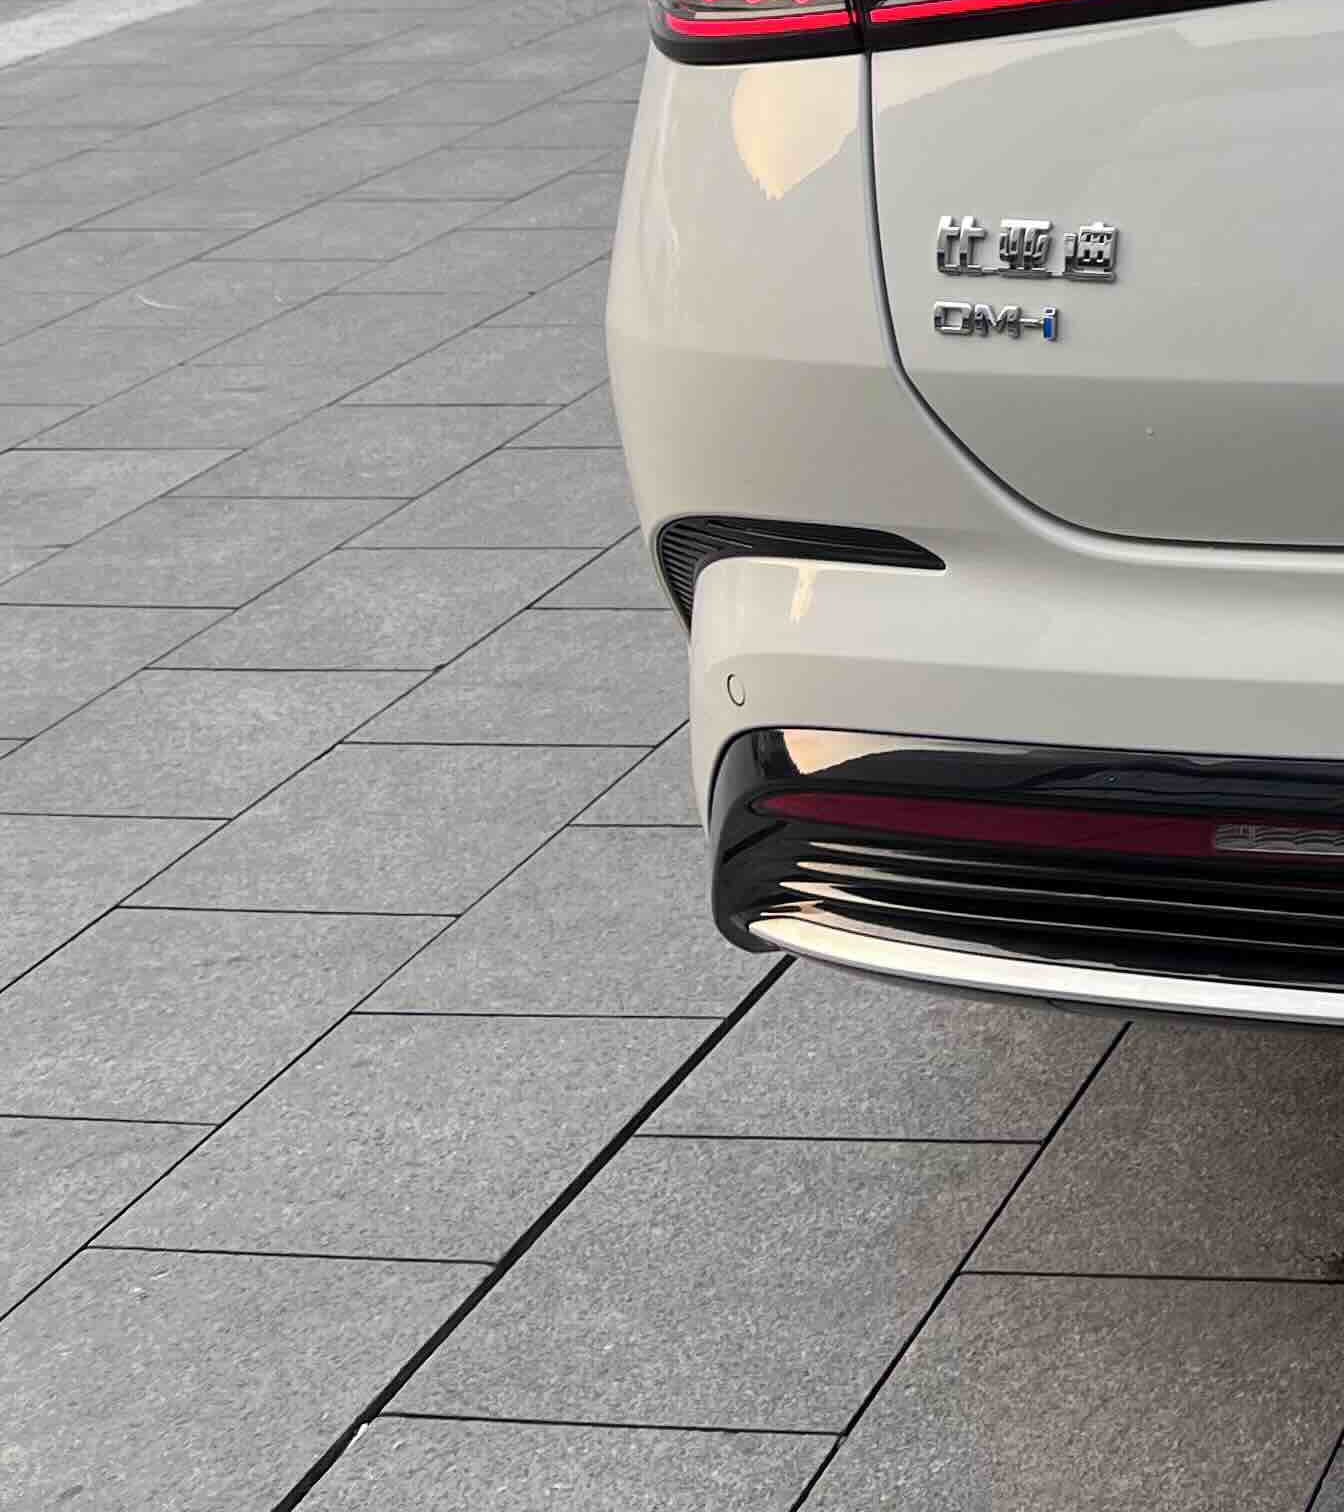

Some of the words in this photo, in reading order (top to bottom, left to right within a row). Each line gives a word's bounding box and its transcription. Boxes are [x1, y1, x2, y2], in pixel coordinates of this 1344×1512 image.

[937, 215, 1117, 281] 比亚迪
[934, 300, 1057, 342] DM-i
